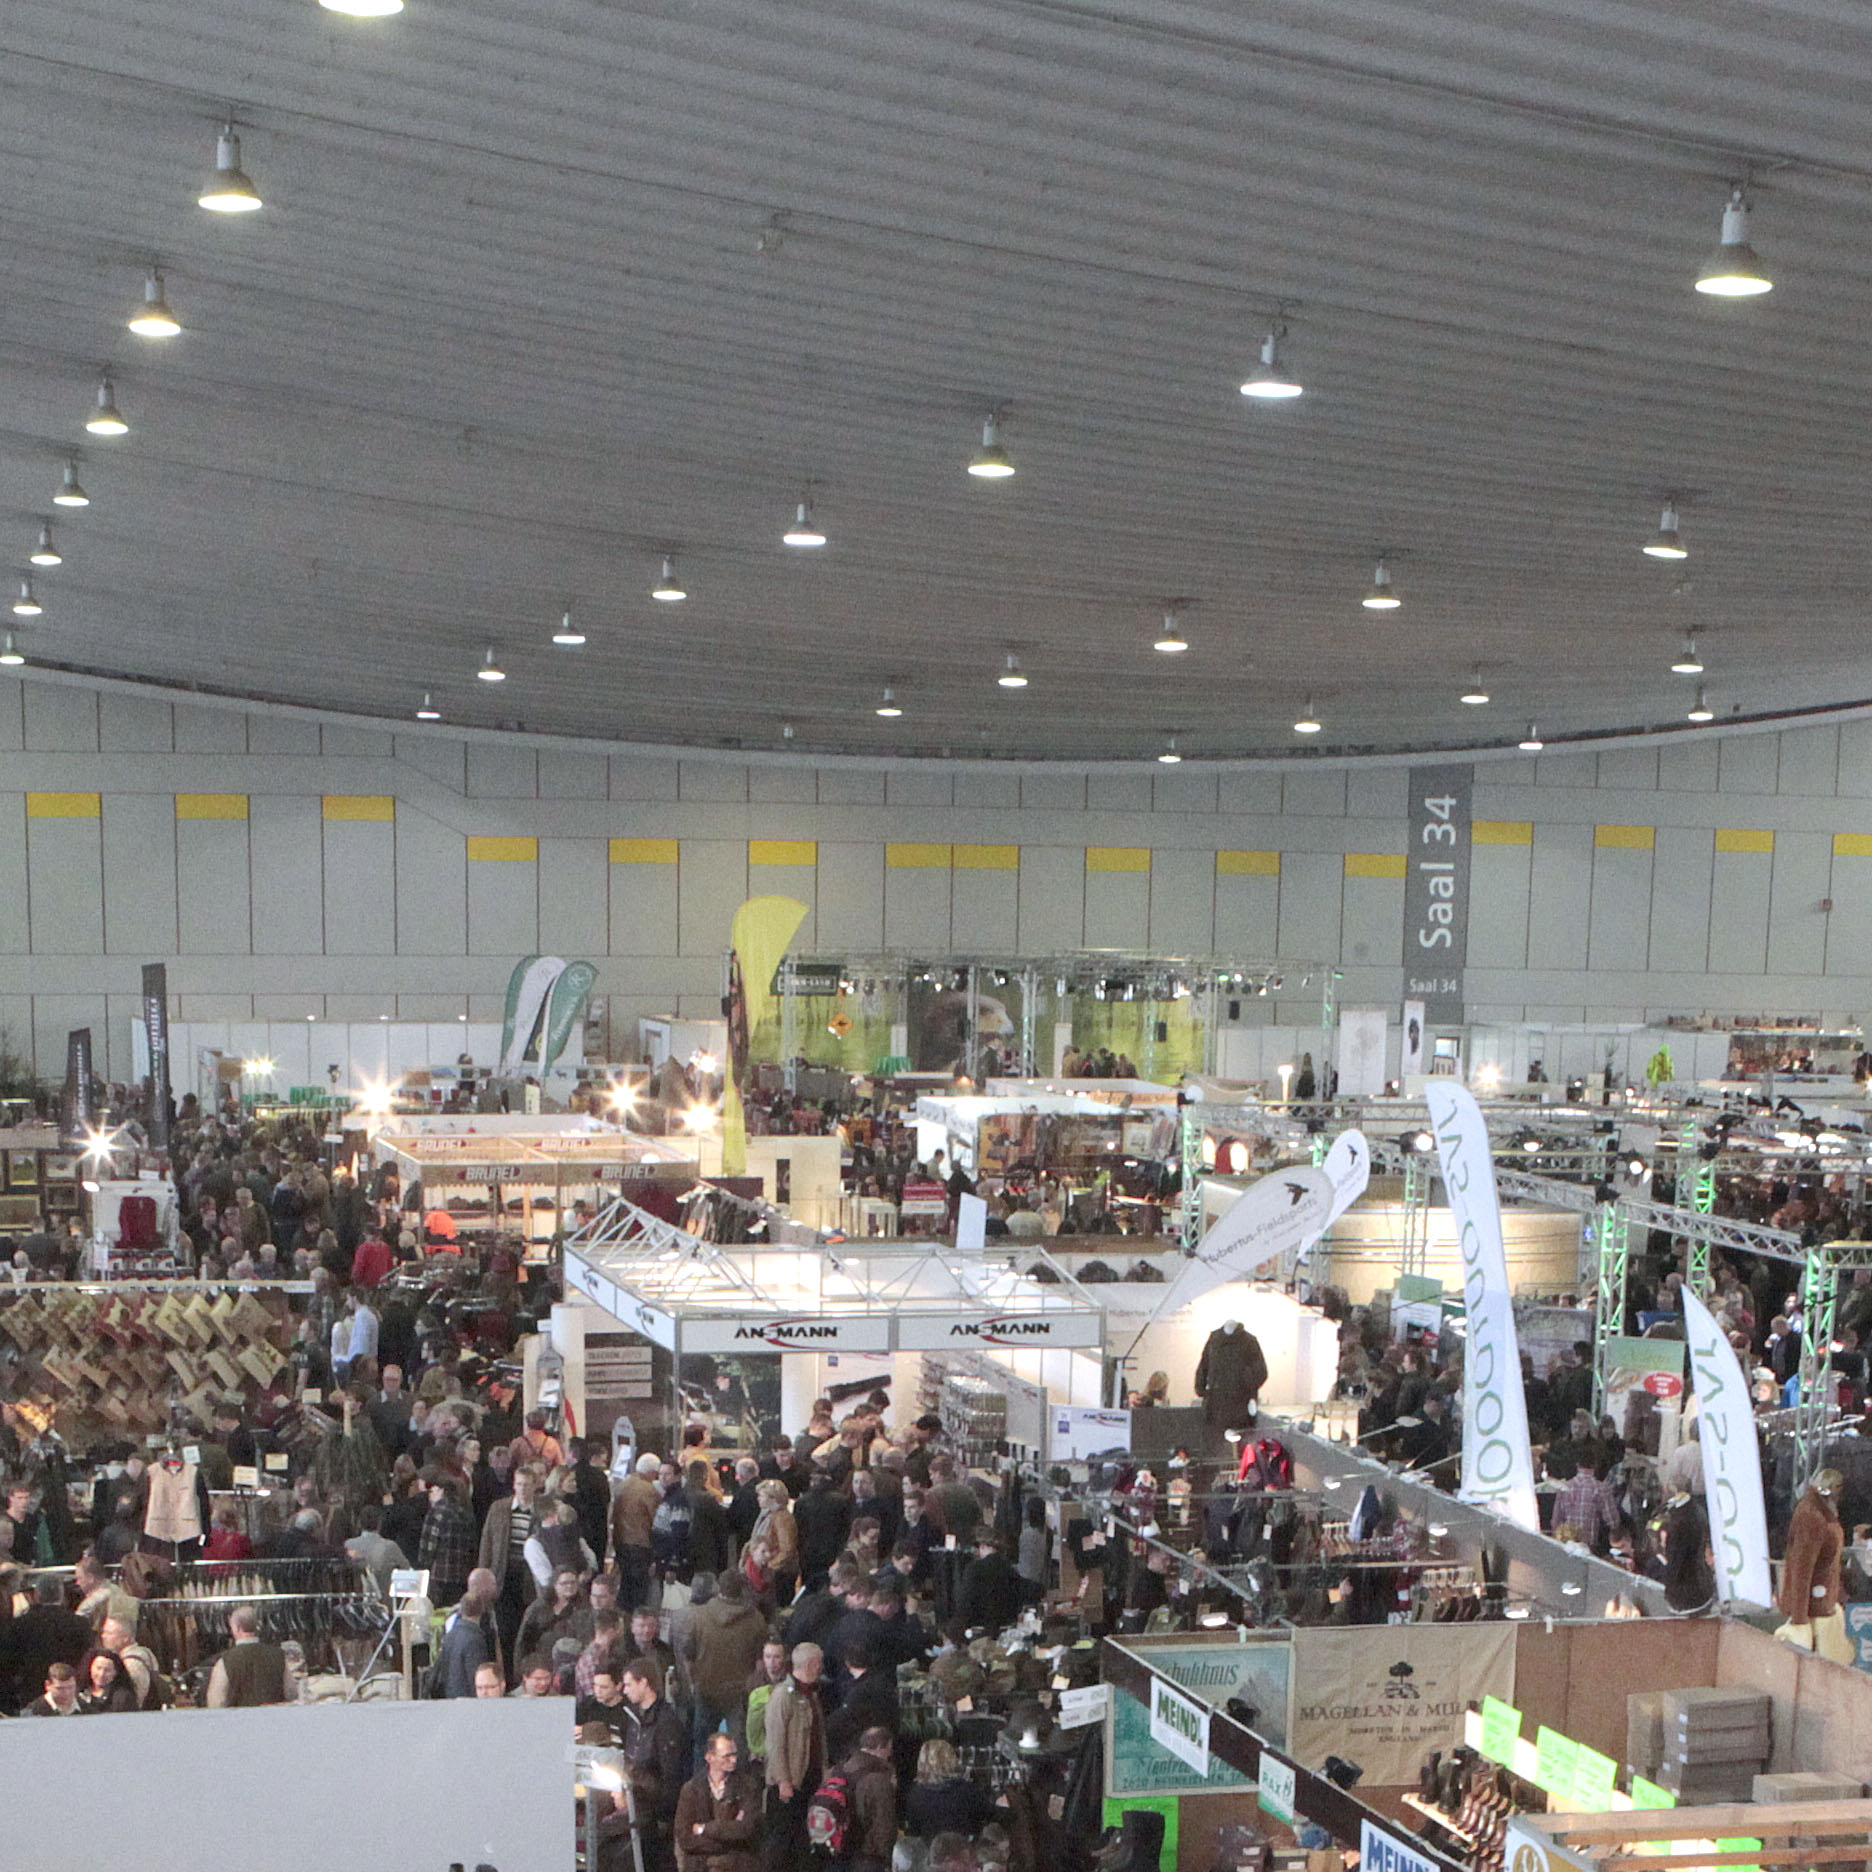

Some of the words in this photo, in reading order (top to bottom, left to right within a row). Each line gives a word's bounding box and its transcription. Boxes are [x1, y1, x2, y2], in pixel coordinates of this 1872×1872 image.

[1423, 795, 1456, 846] 34
[1420, 862, 1454, 948] Saal
[1408, 978, 1438, 993] Saal
[1440, 978, 1458, 993] 34
[734, 1326, 838, 1339] ANSMANN
[951, 1322, 1051, 1336] ANSMANN
[1157, 1661, 1242, 1688] chuhhaus
[1299, 1703, 1402, 1721] MAGELLAN
